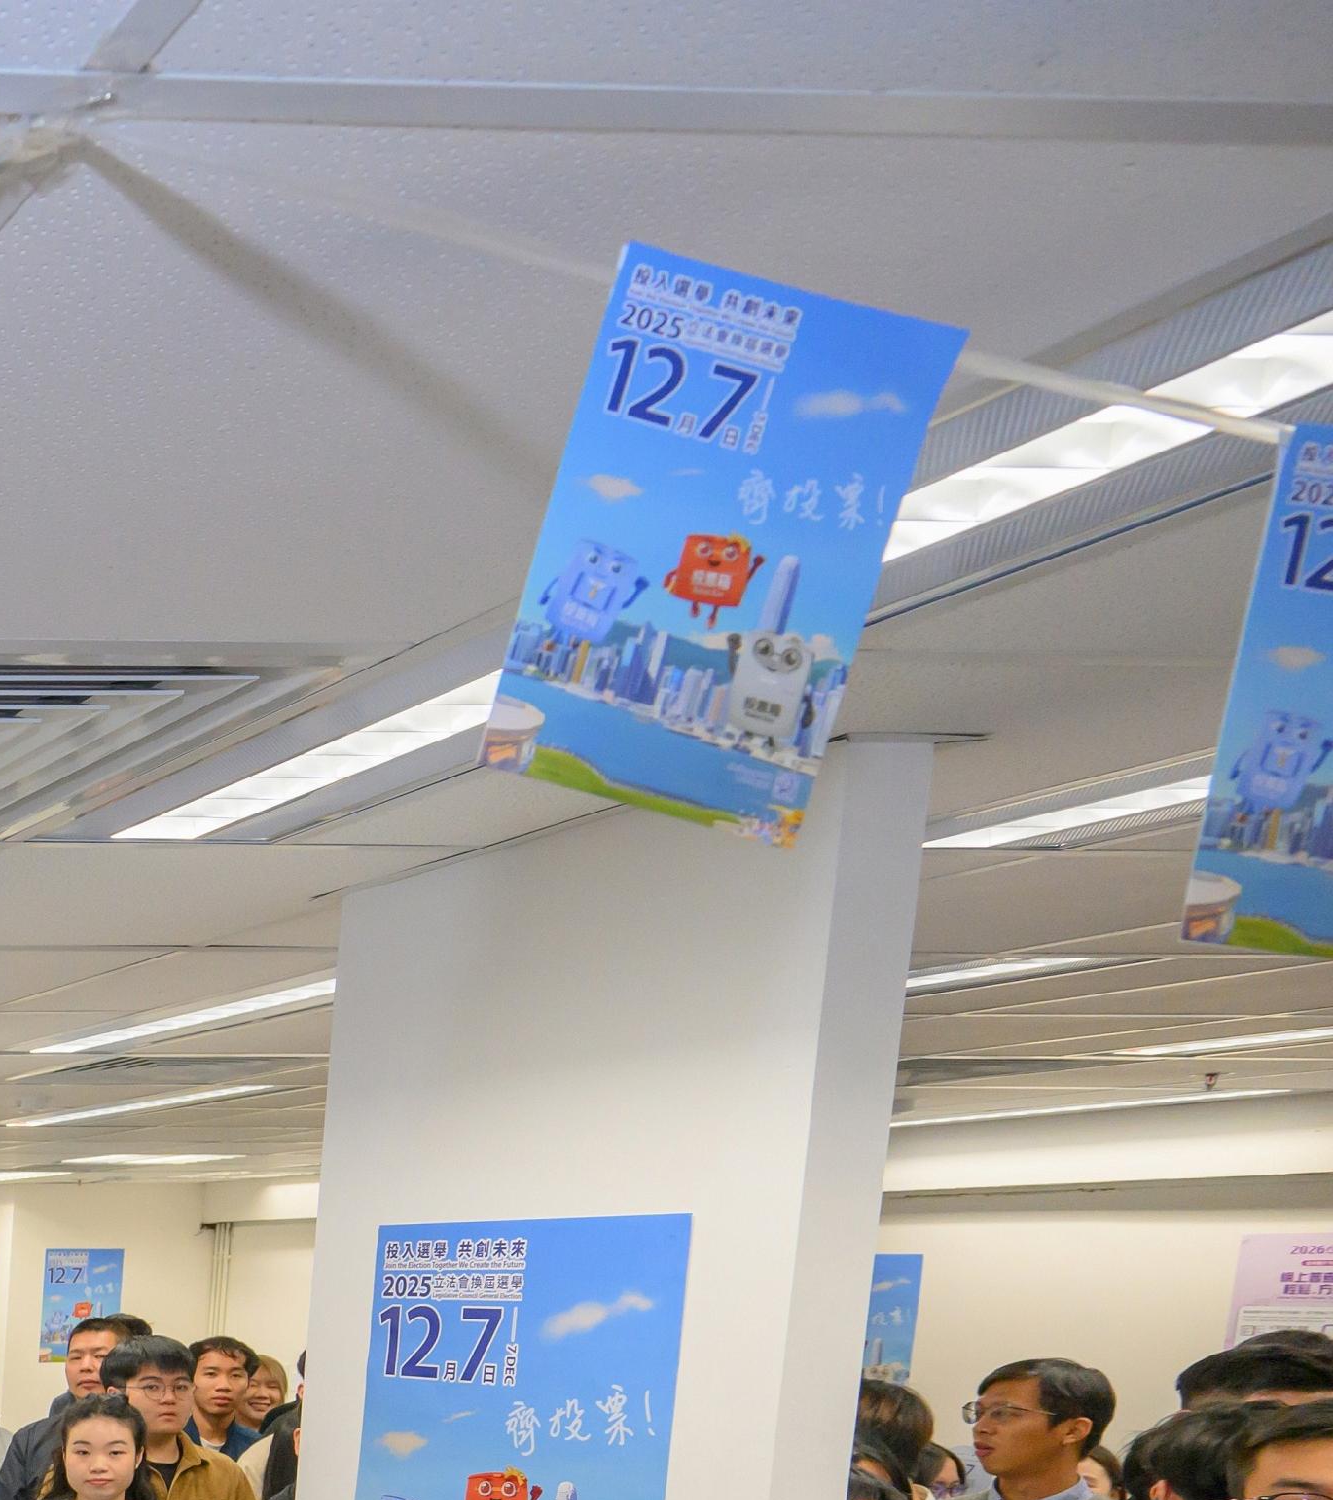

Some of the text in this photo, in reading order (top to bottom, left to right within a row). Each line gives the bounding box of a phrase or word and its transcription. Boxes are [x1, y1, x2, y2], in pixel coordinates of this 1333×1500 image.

[386, 1238, 526, 1260] 投入選舉 共創未來
[408, 1261, 432, 1270] Election
[432, 1261, 458, 1272] Together
[458, 1261, 469, 1269] We
[469, 1260, 490, 1270] Create
[490, 1260, 502, 1269] the
[502, 1260, 525, 1270] Future
[379, 1305, 503, 1385] 12月7日
[503, 1345, 517, 1386] 7 DEC
